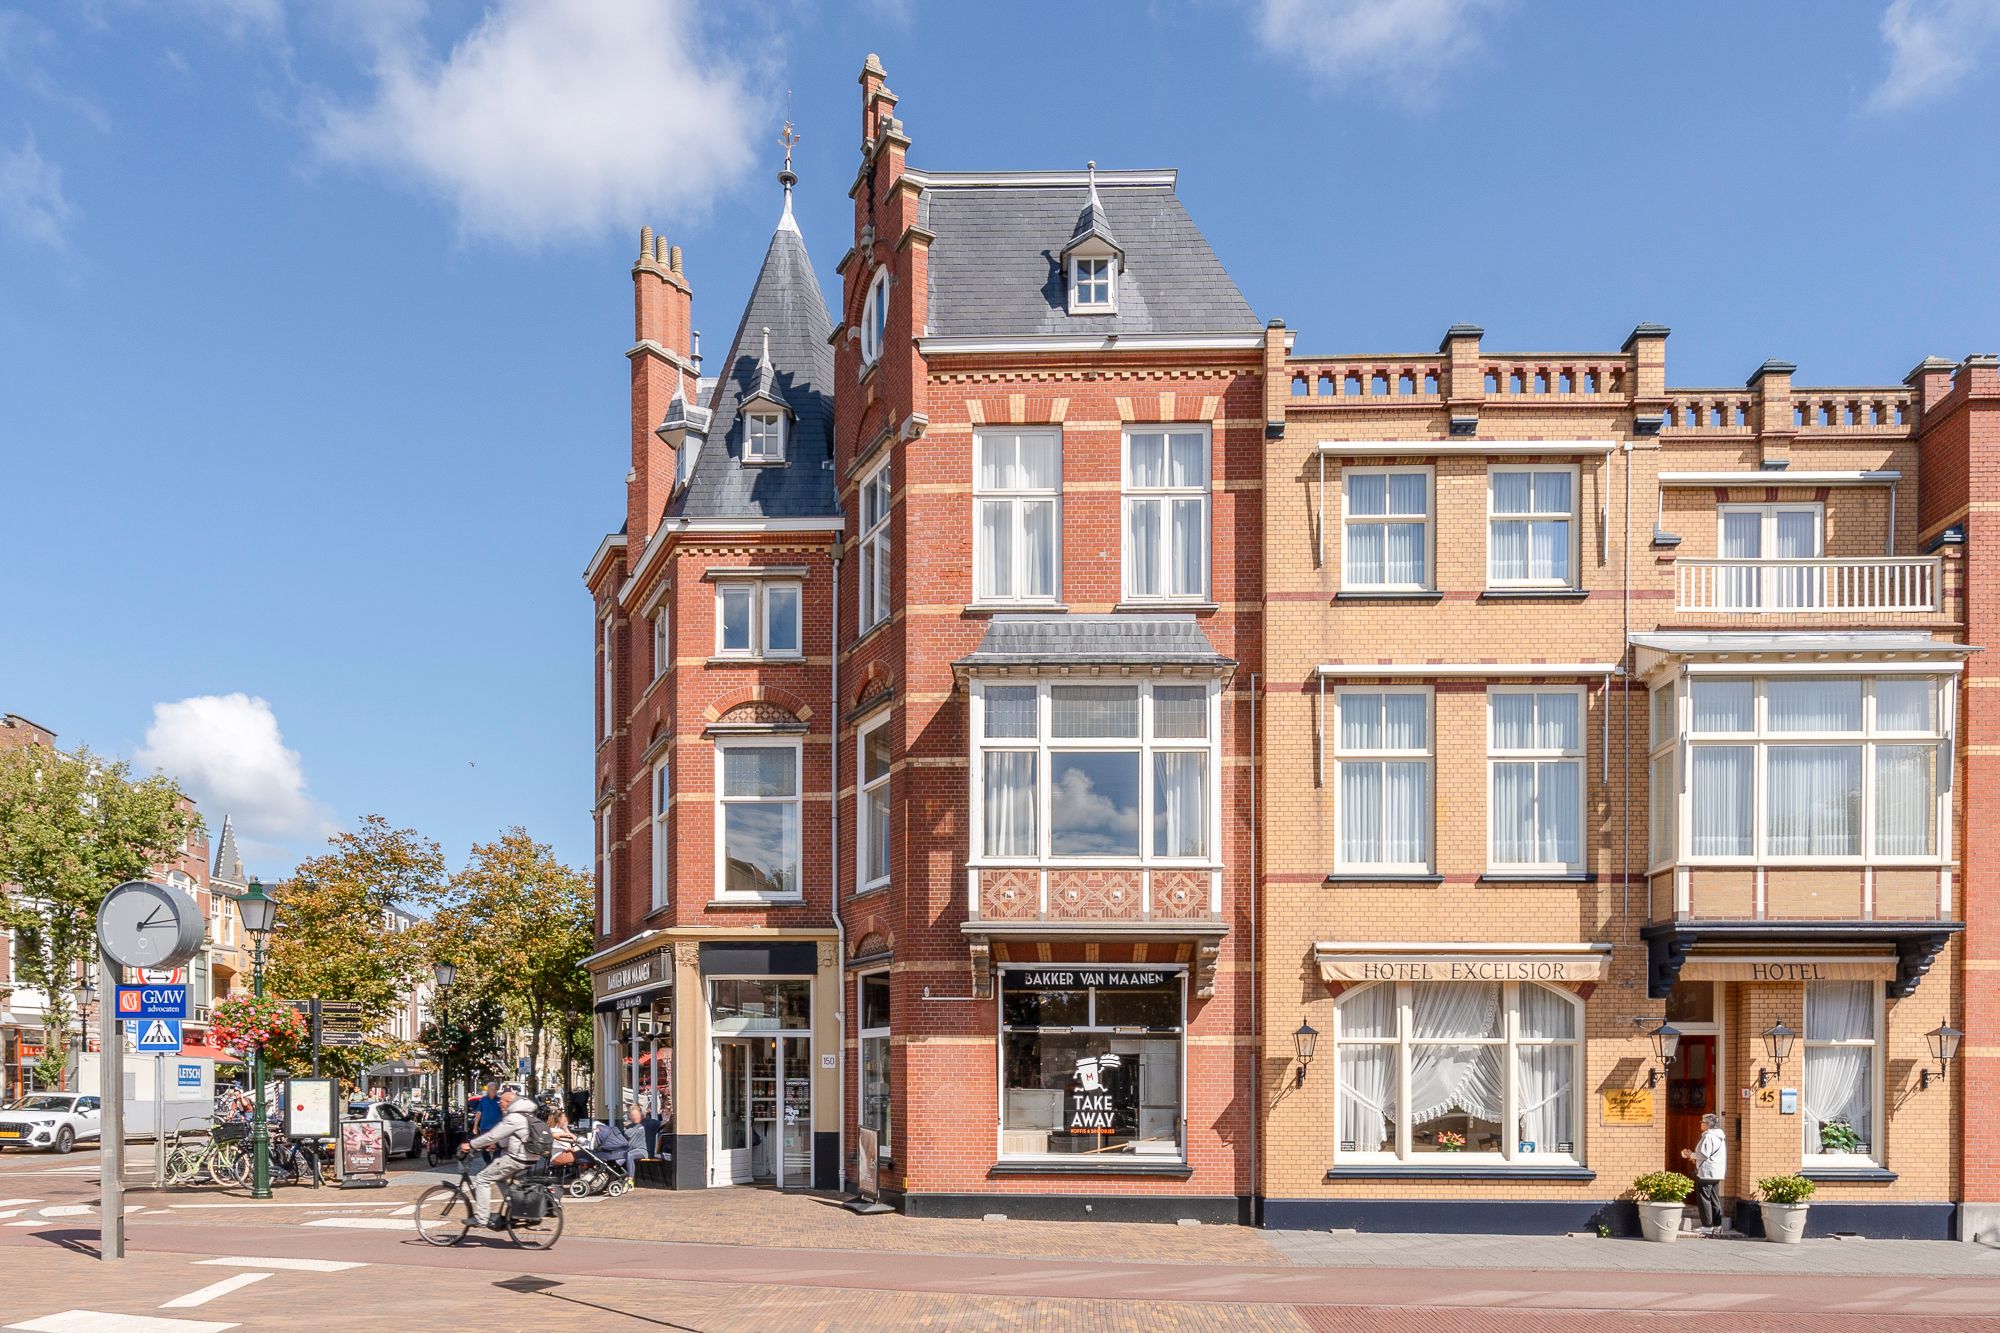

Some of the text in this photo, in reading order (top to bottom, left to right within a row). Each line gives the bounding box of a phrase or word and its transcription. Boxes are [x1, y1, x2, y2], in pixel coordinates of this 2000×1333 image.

[1363, 962, 1566, 980] HOTEL EXCELSIOR
[1751, 962, 1826, 981] HOTEL
[1024, 972, 1164, 986] BAKKER VAN MAANEN
[142, 989, 185, 1004] GMW
[147, 1005, 180, 1013] advocaten
[823, 1057, 835, 1065] 150
[179, 1067, 201, 1079] LETSCH
[1085, 1072, 1094, 1081] M
[1073, 1095, 1113, 1111] TAKE
[1760, 1091, 1775, 1103] 45
[1071, 1112, 1115, 1128] AWAY
